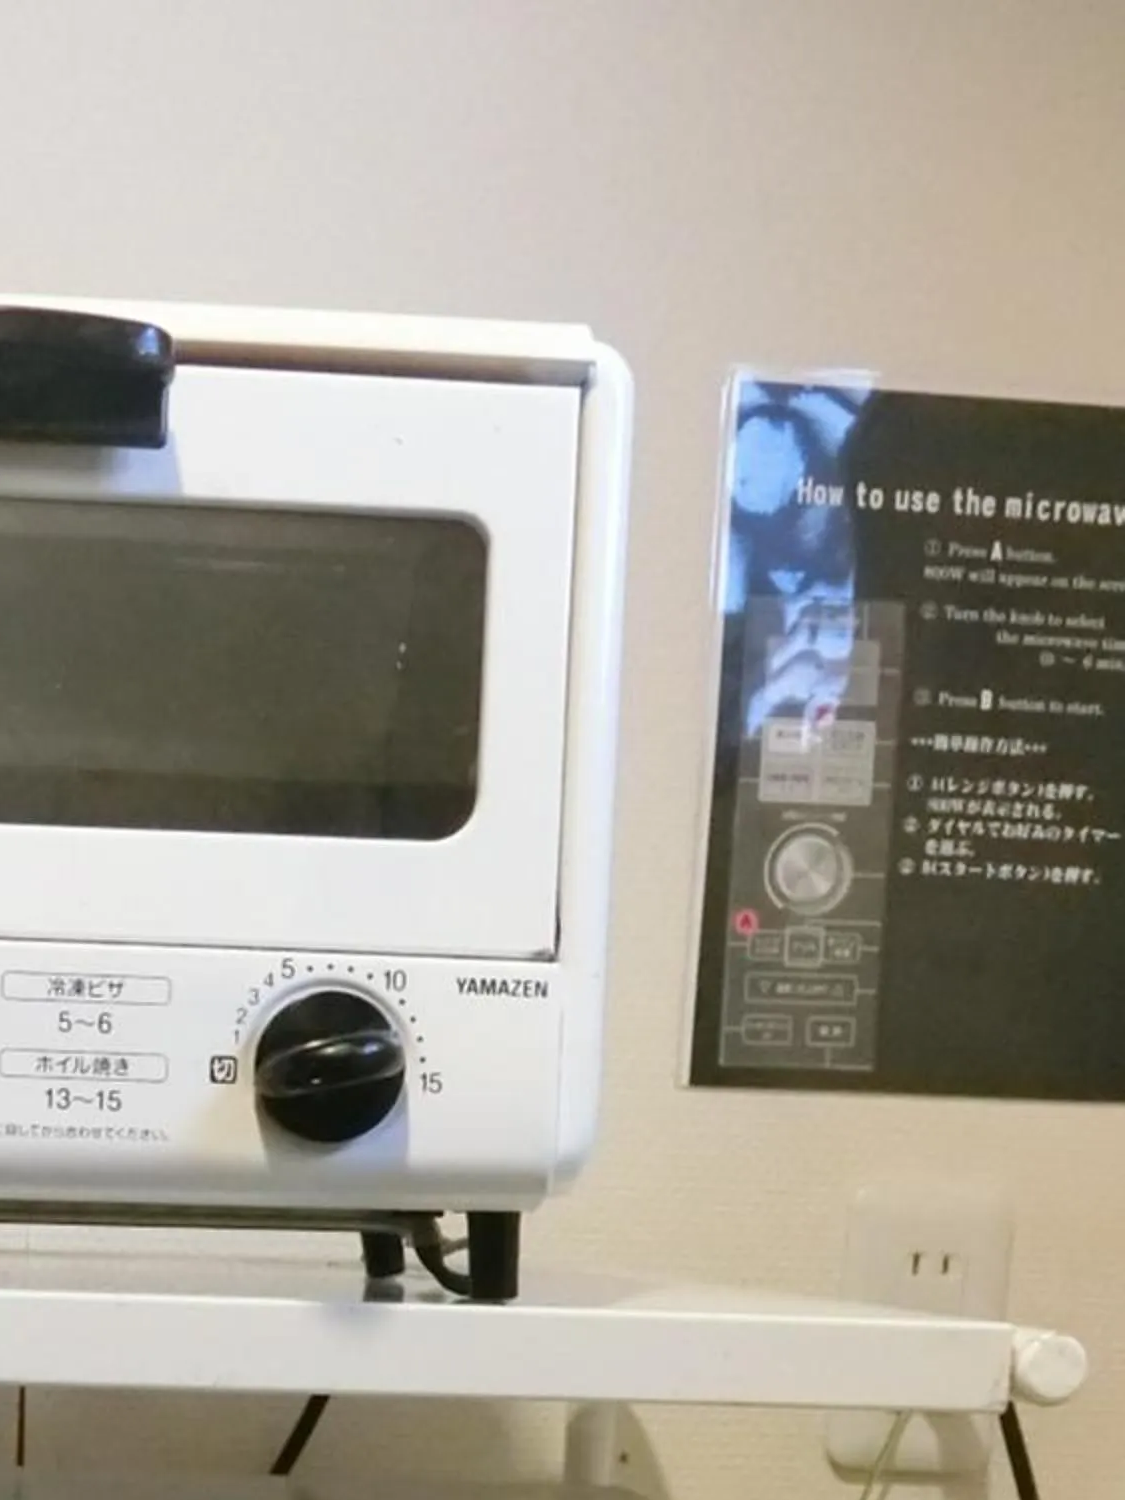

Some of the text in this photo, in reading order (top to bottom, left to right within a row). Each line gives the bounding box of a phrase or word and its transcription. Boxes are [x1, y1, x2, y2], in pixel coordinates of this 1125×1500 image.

[797, 477, 843, 506] How
[856, 481, 884, 509] to
[894, 488, 941, 514] use
[953, 486, 996, 517] the
[990, 540, 1003, 561] A
[944, 604, 979, 622] Turn
[983, 607, 1006, 624] the
[1048, 611, 1063, 627] to
[1049, 697, 1063, 713] to
[281, 958, 296, 979] 5
[263, 972, 274, 987] 4
[383, 971, 407, 992] 10
[456, 977, 549, 999] YAMAZEN
[250, 988, 261, 1004] 3
[236, 1009, 247, 1025] 2
[420, 1072, 443, 1094] 15
